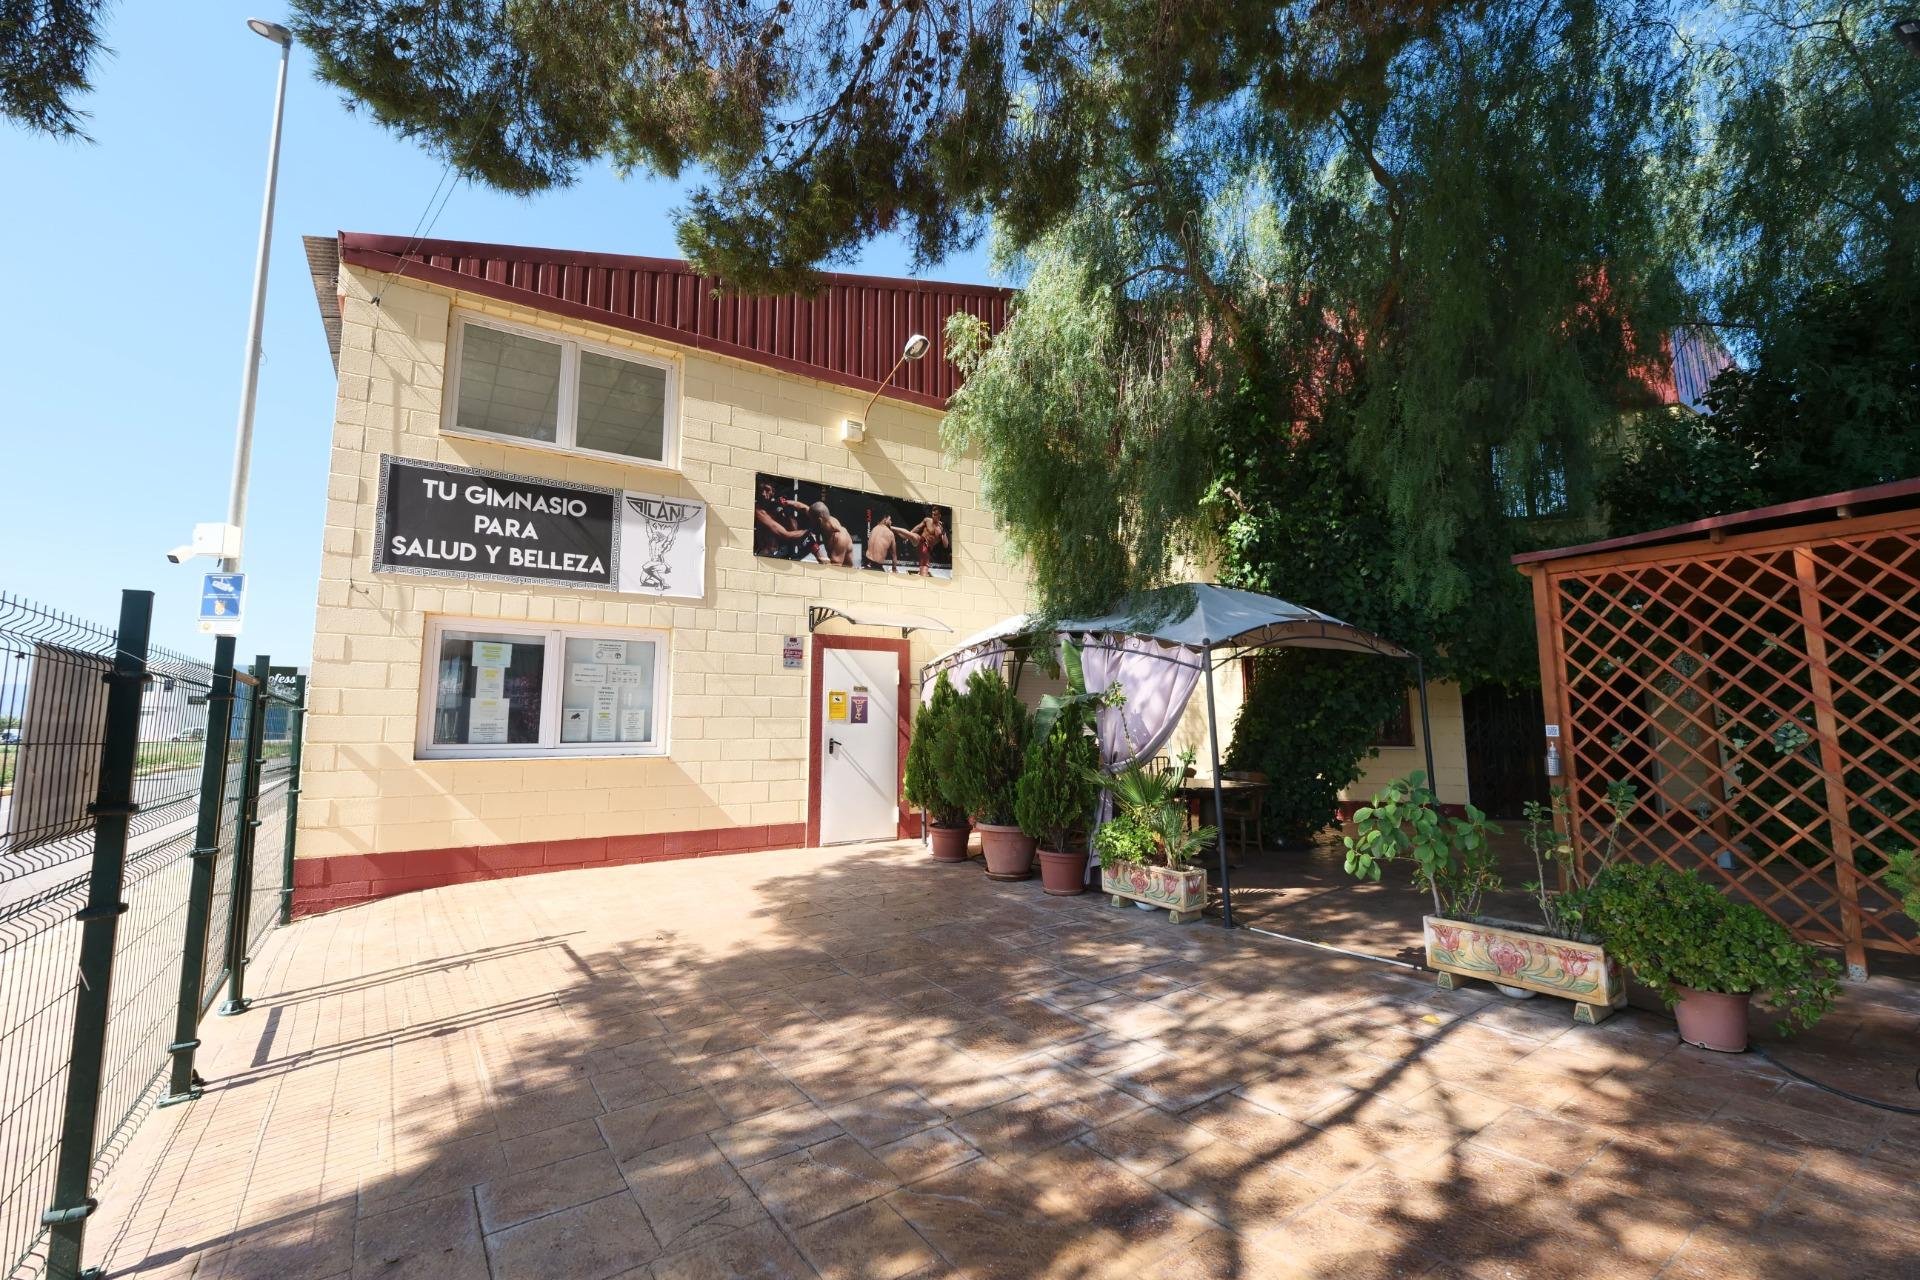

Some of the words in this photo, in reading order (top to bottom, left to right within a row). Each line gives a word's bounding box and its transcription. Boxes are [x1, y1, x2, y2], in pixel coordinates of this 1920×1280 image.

[422, 478, 457, 500] TU
[465, 485, 587, 517] GIMNASIO
[474, 514, 539, 540] PARA
[652, 522, 673, 531] GYM
[391, 536, 477, 562] SALUD
[484, 545, 502, 564] Y
[509, 547, 605, 574] BELLEZA
[268, 673, 297, 684] ofess
